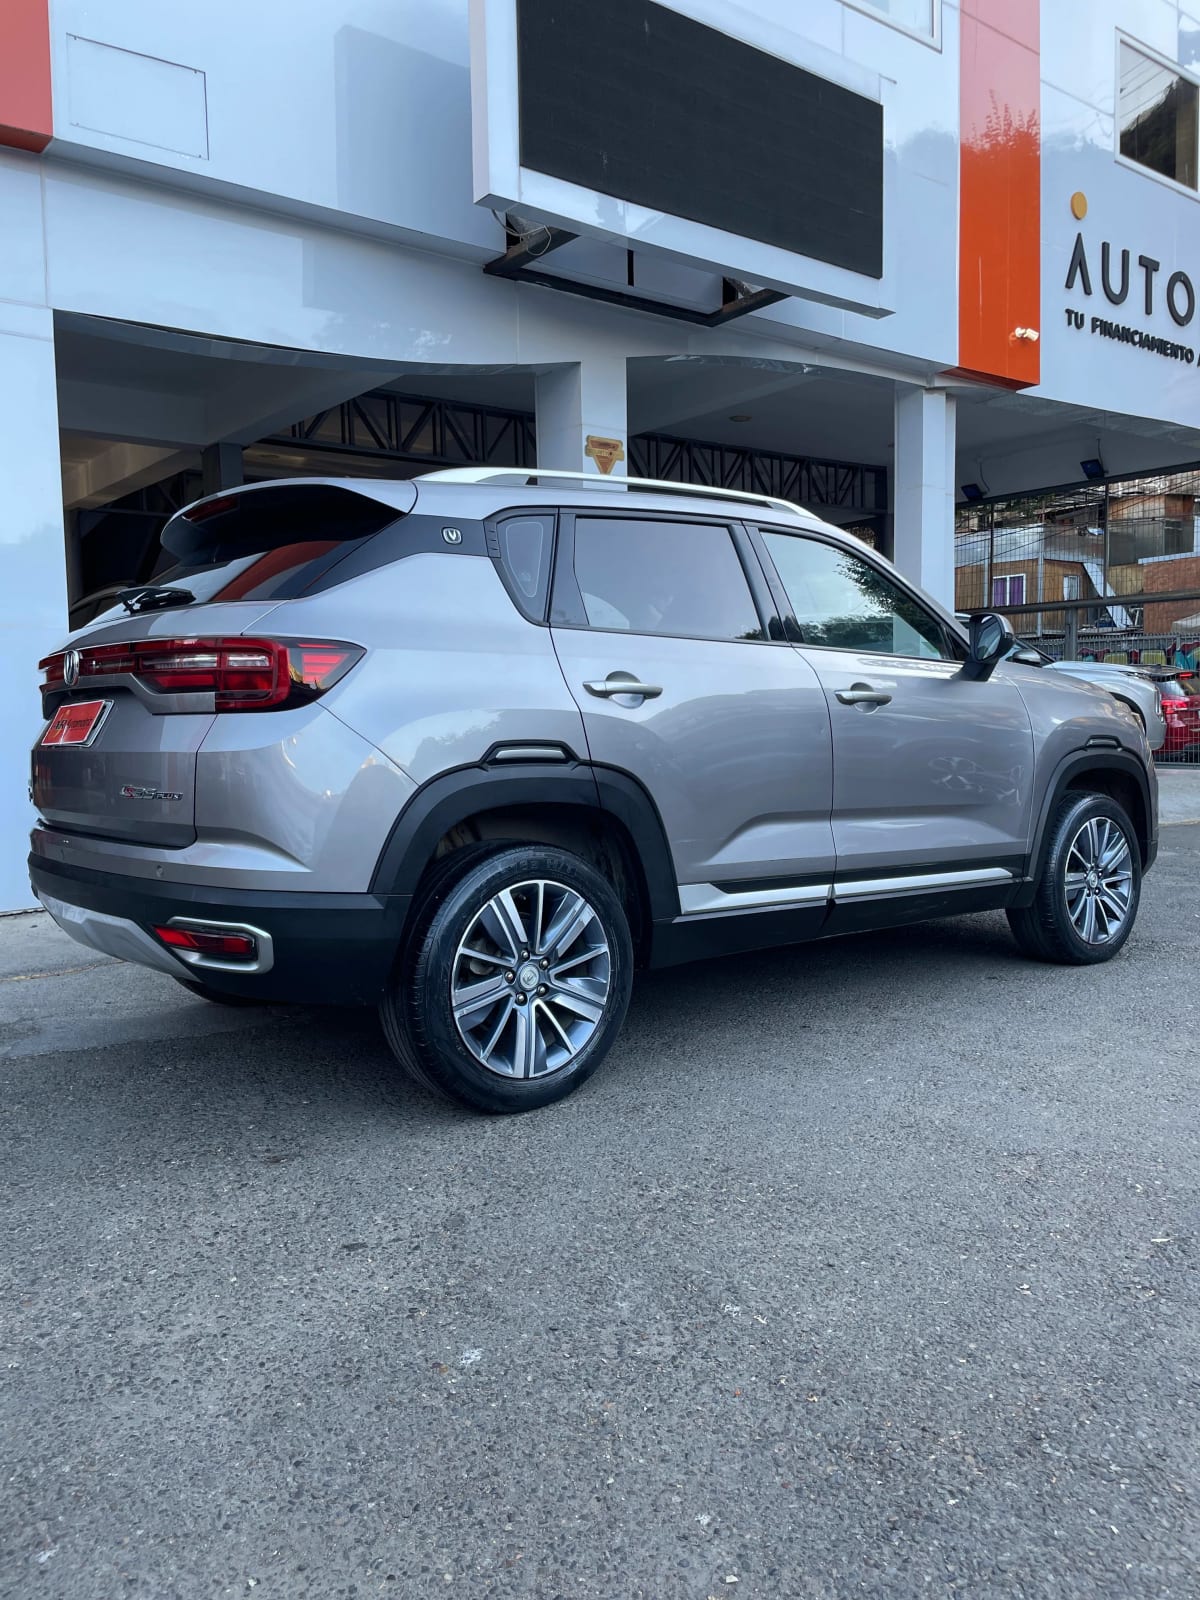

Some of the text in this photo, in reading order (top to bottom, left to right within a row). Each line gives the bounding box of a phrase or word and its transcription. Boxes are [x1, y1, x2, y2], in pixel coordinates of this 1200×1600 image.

[1065, 232, 1195, 327] AUTO
[1065, 308, 1085, 330] TU
[1091, 316, 1195, 364] FINANCIAMIENTO
